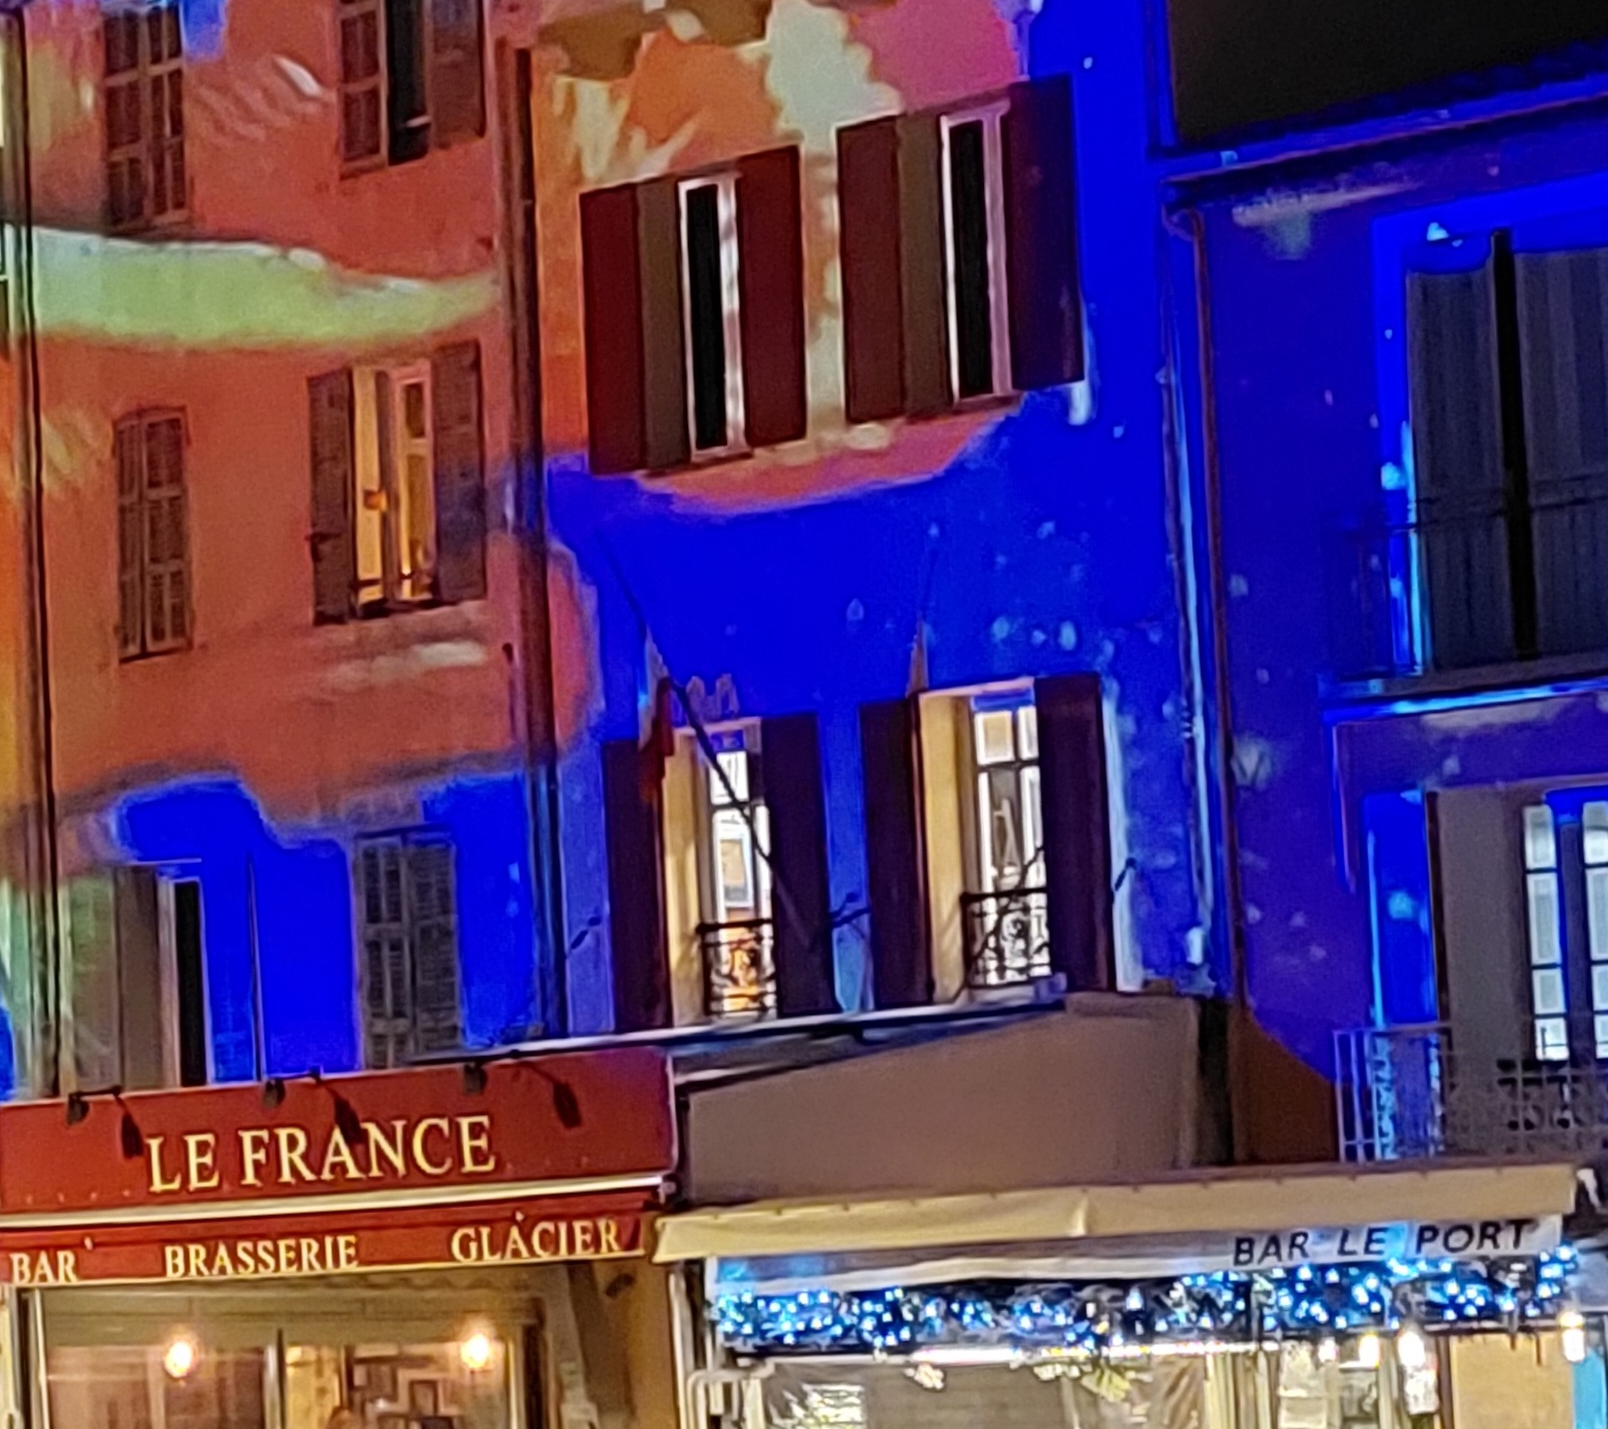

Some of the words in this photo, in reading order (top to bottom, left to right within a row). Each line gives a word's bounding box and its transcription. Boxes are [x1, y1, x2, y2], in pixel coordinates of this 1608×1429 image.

[145, 1133, 219, 1192] LE
[237, 1115, 496, 1185] FRANCE
[164, 1235, 360, 1278] BRASSERIE
[1233, 1230, 1310, 1266] BAR
[1337, 1227, 1388, 1256] LE
[1415, 1219, 1537, 1255] PORT
[9, 1250, 78, 1284] BAR
